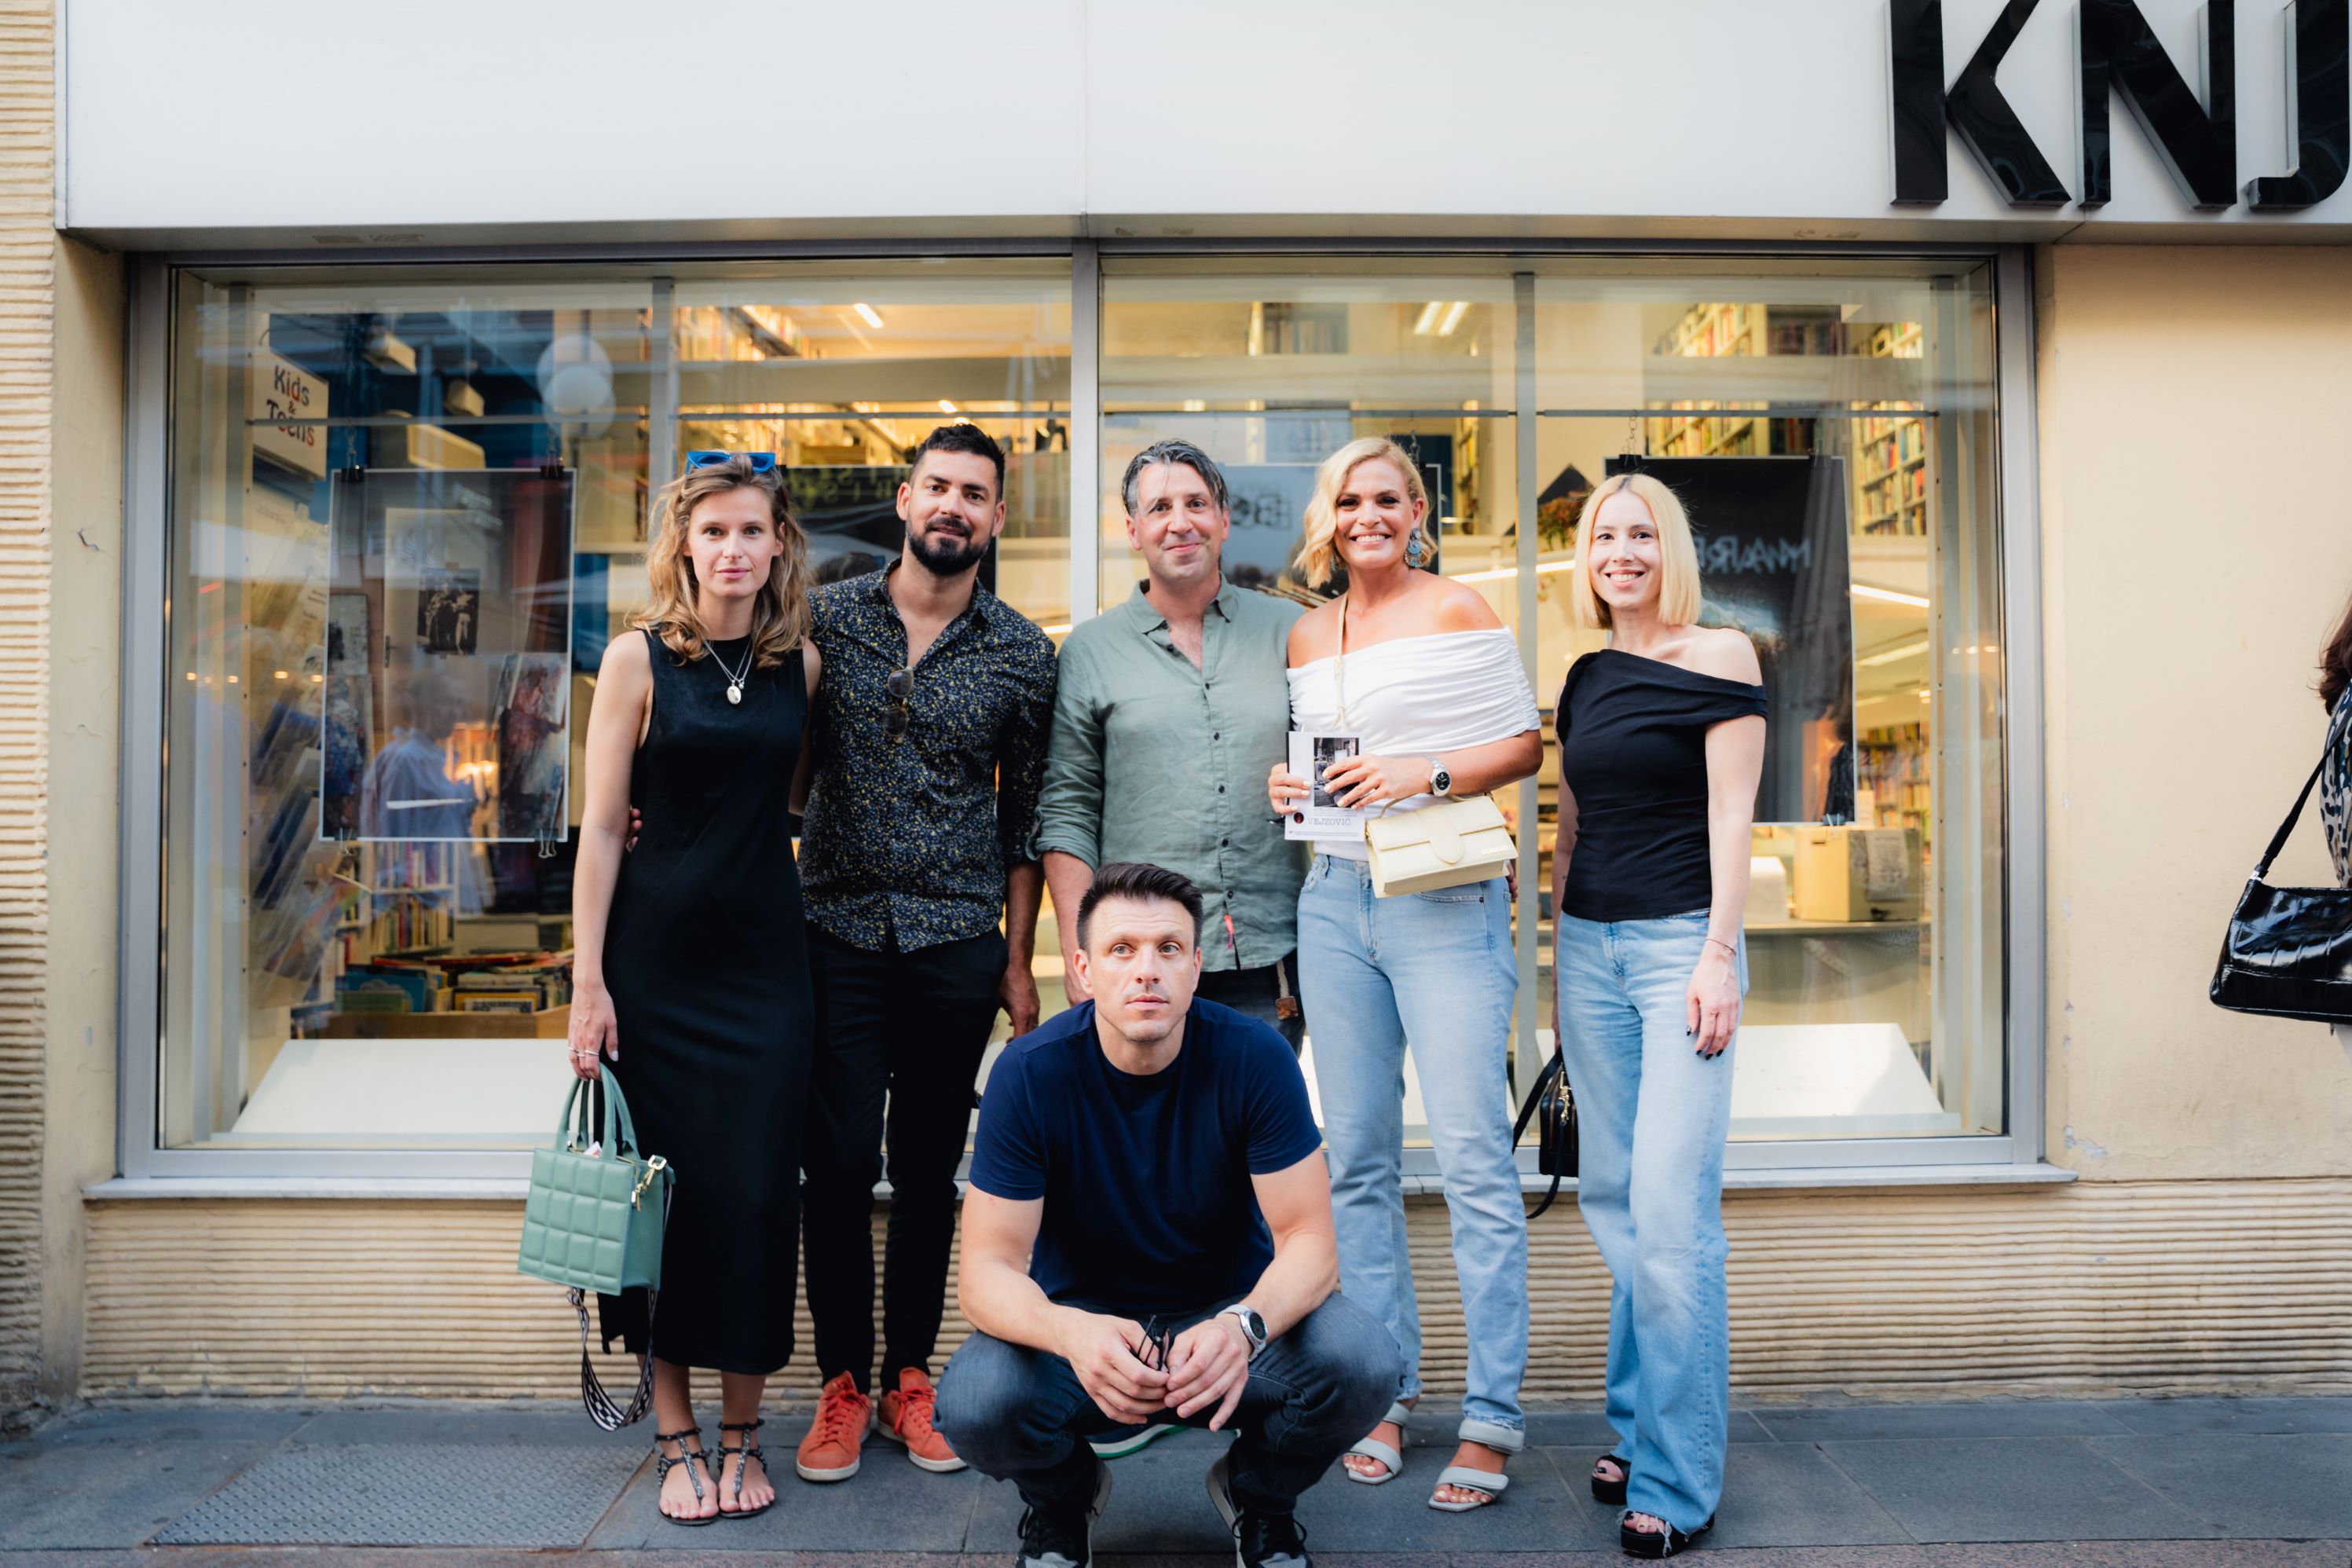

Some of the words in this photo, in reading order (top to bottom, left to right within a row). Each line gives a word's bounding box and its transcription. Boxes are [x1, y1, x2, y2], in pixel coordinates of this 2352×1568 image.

[1889, 0, 2350, 208] KNJ
[274, 365, 310, 407] Kids
[288, 401, 296, 415] &
